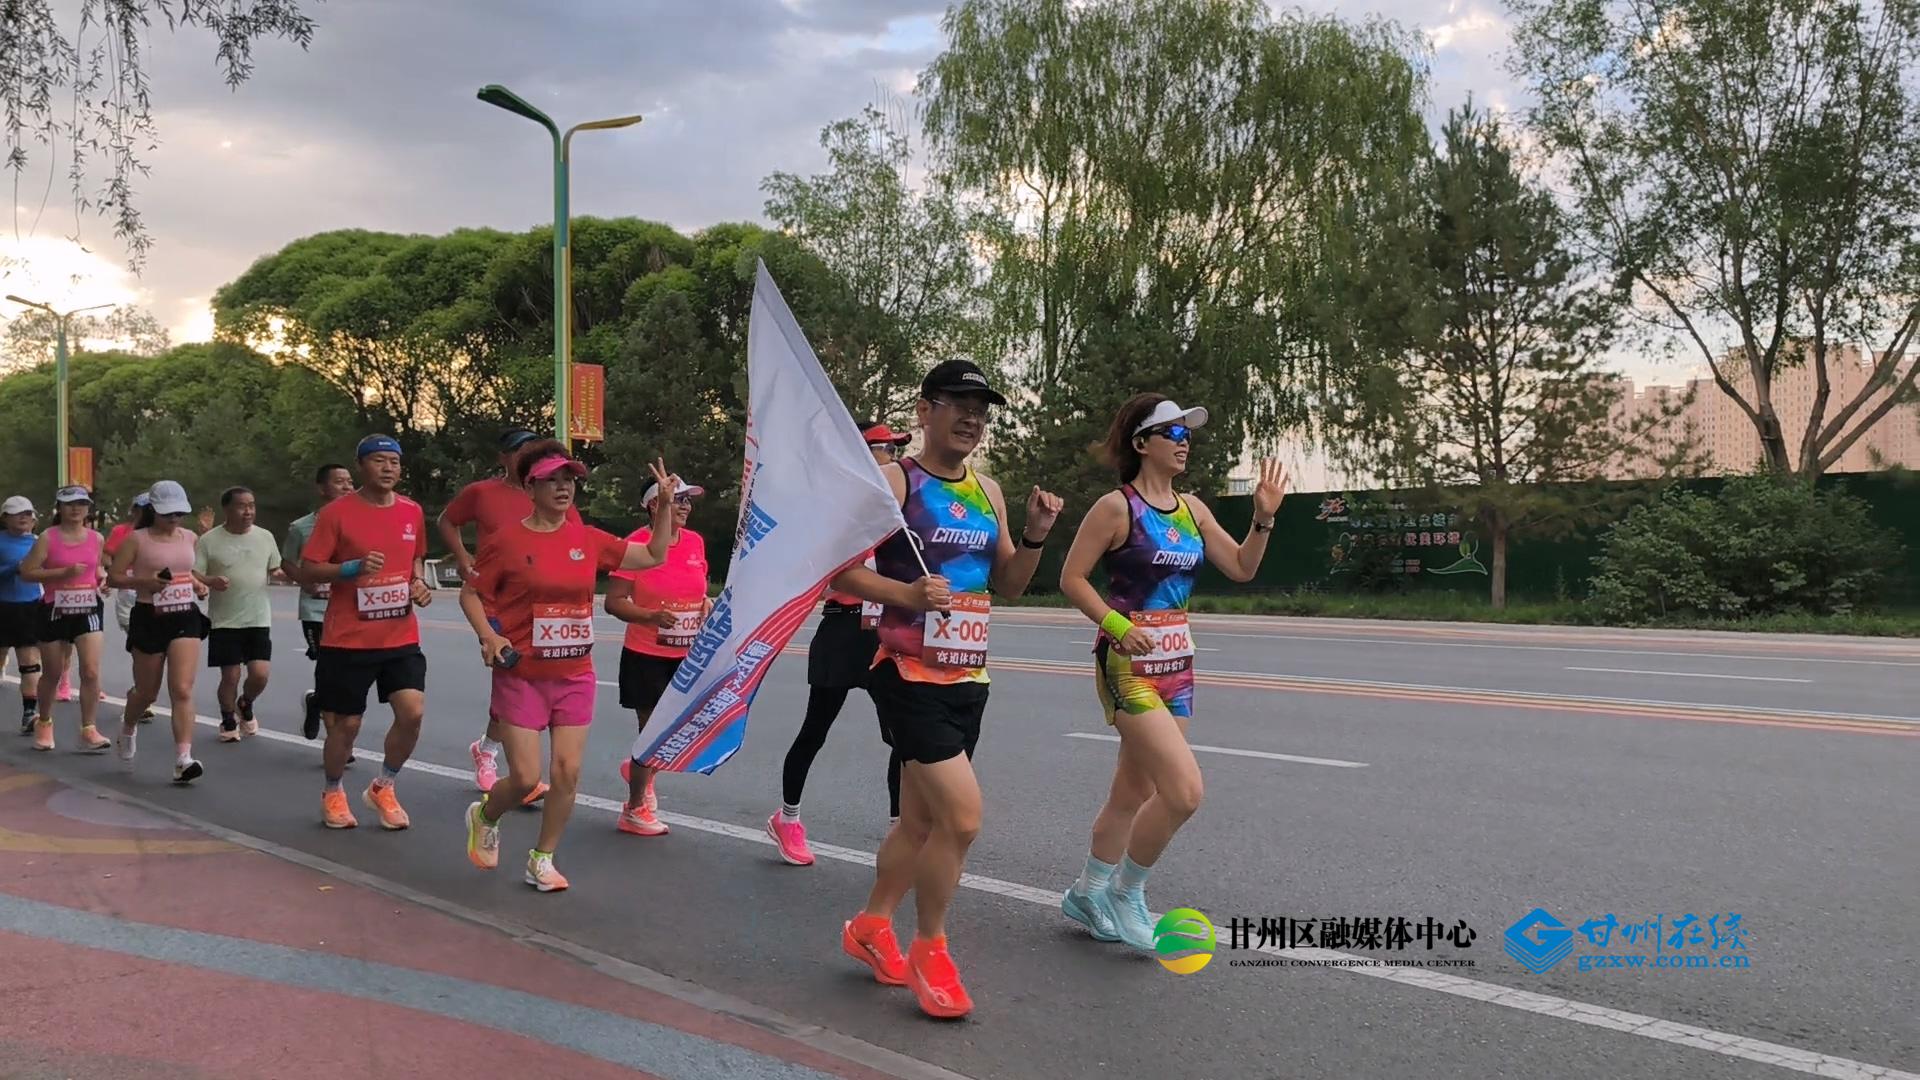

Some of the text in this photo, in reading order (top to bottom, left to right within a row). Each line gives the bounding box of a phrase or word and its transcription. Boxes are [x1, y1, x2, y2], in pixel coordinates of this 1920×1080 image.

[363, 589, 407, 606] X-056
[540, 623, 590, 640] X-053
[1150, 631, 1189, 653] -006
